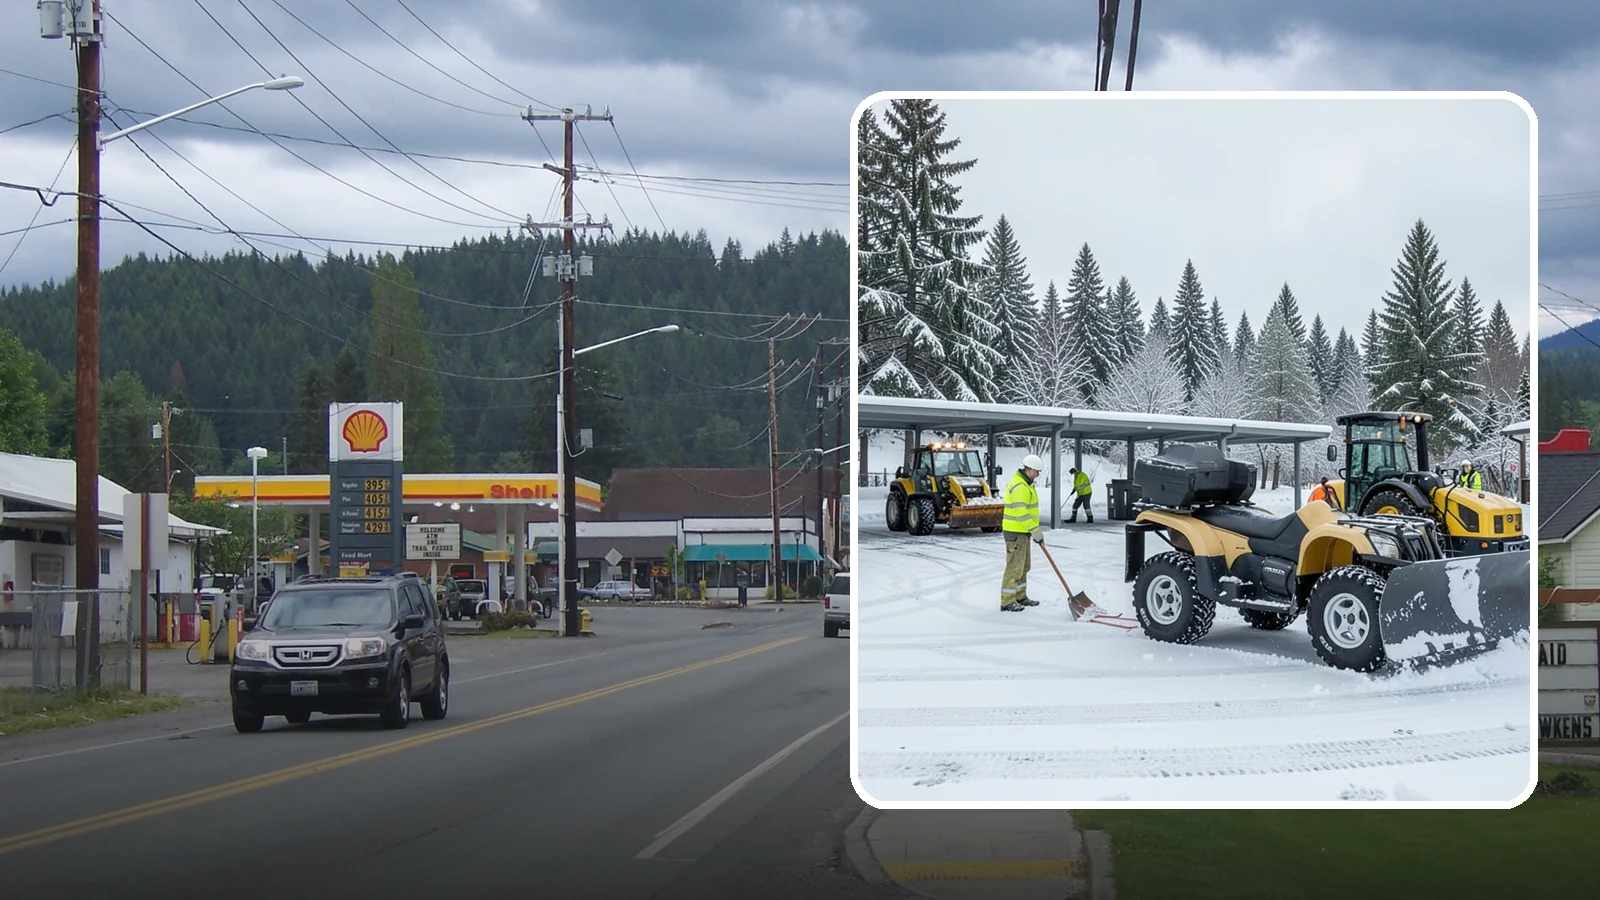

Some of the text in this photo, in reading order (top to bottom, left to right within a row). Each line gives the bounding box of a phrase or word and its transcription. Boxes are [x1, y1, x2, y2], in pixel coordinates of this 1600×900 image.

[490, 484, 548, 499] Shell
[1538, 642, 1567, 665] AID
[1538, 715, 1592, 739] WKENS
